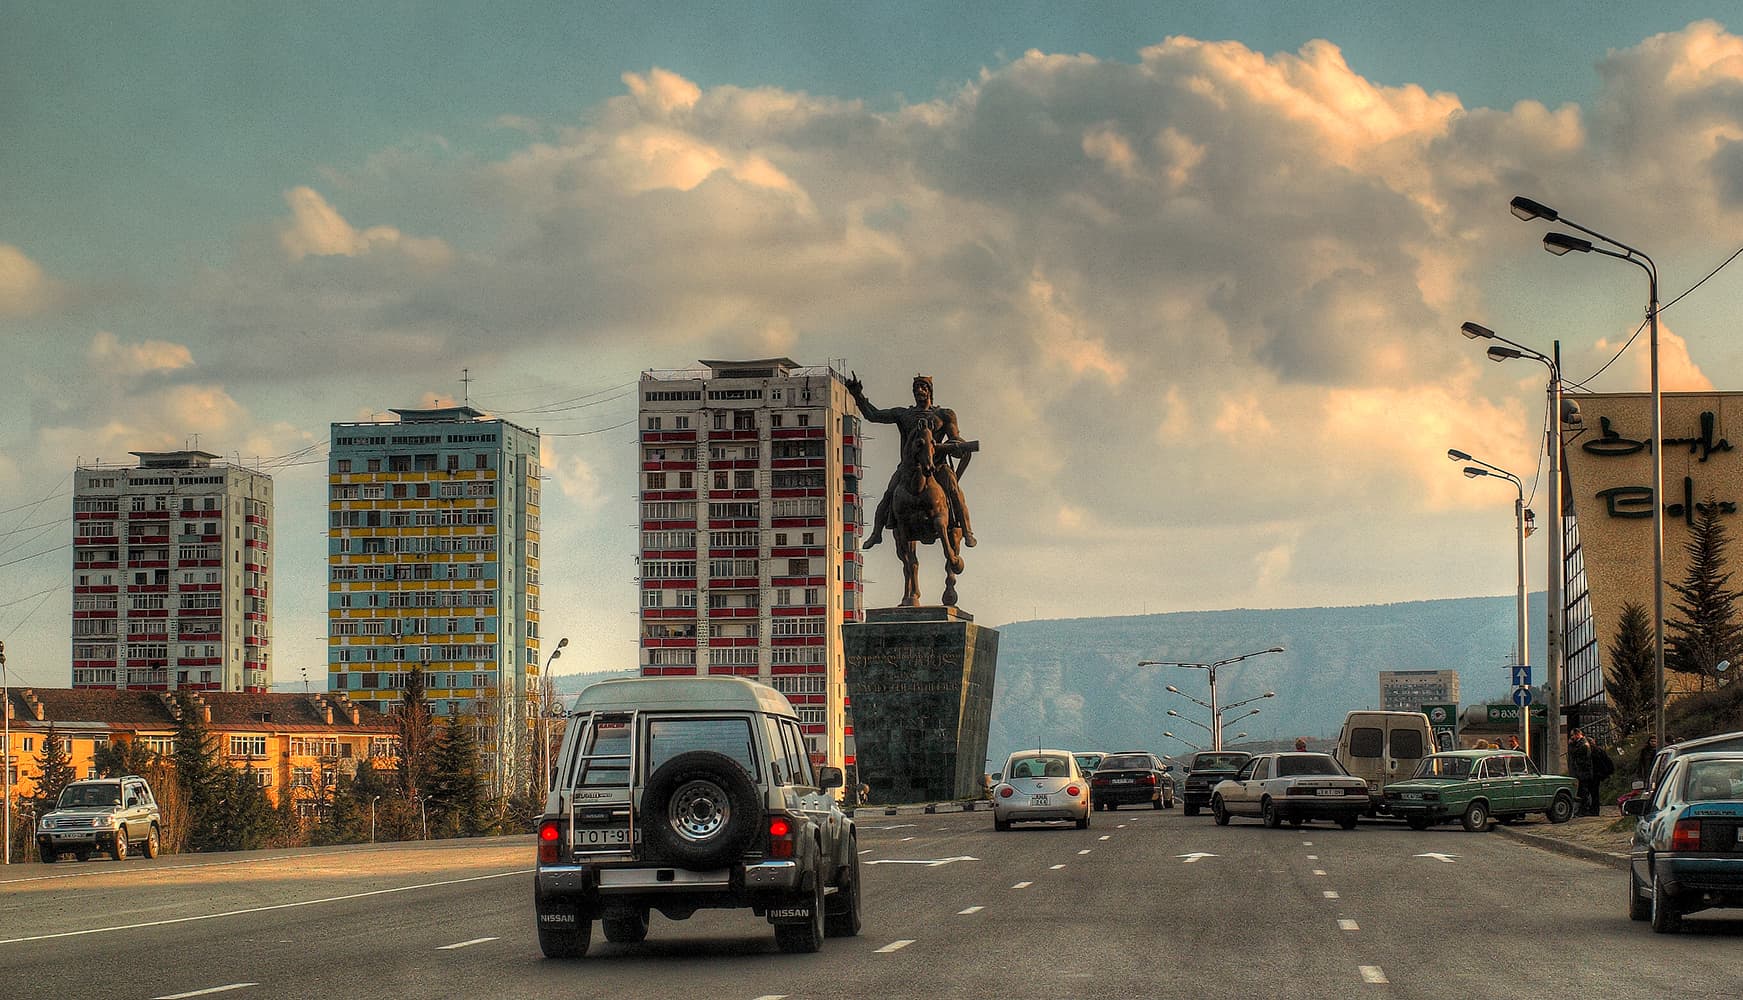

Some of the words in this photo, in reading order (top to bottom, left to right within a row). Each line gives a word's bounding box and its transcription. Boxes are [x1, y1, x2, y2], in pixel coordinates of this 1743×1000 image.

[577, 830, 639, 843] TOT-910
[540, 914, 575, 922] NISSAN
[770, 909, 809, 918] NISSAN
